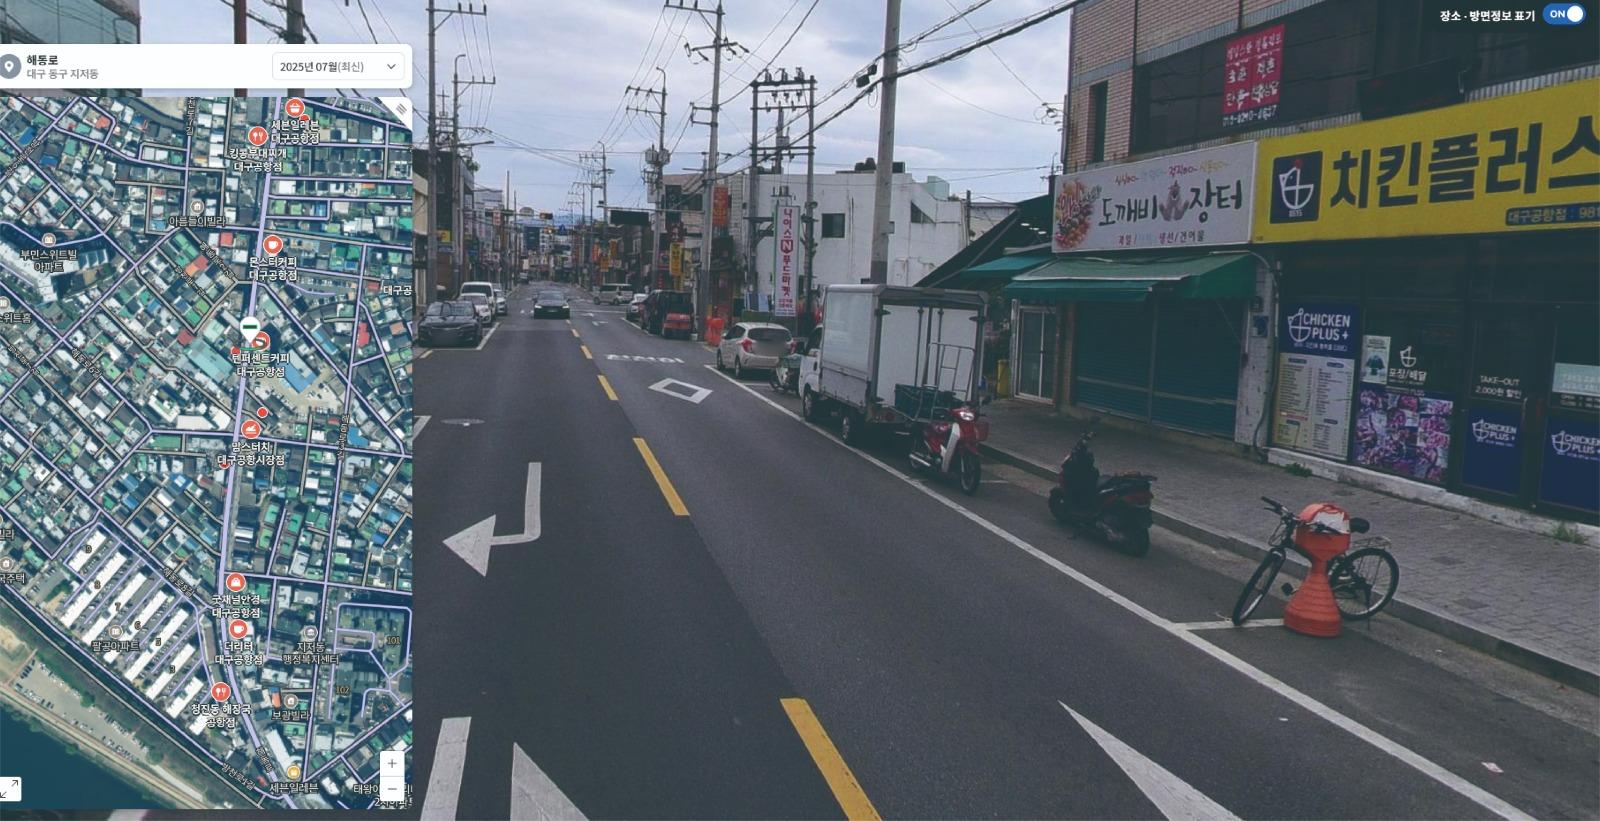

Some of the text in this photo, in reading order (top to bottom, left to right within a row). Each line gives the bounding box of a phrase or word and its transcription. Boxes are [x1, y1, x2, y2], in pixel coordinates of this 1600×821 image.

[1330, 115, 1600, 209] 치킨플러스
[1099, 195, 1157, 226] 도깨비
[1190, 178, 1243, 223] 장터
[783, 208, 793, 239] 나이스
[1303, 313, 1351, 328] CHICKEN
[1484, 422, 1517, 434] CHICKEN
